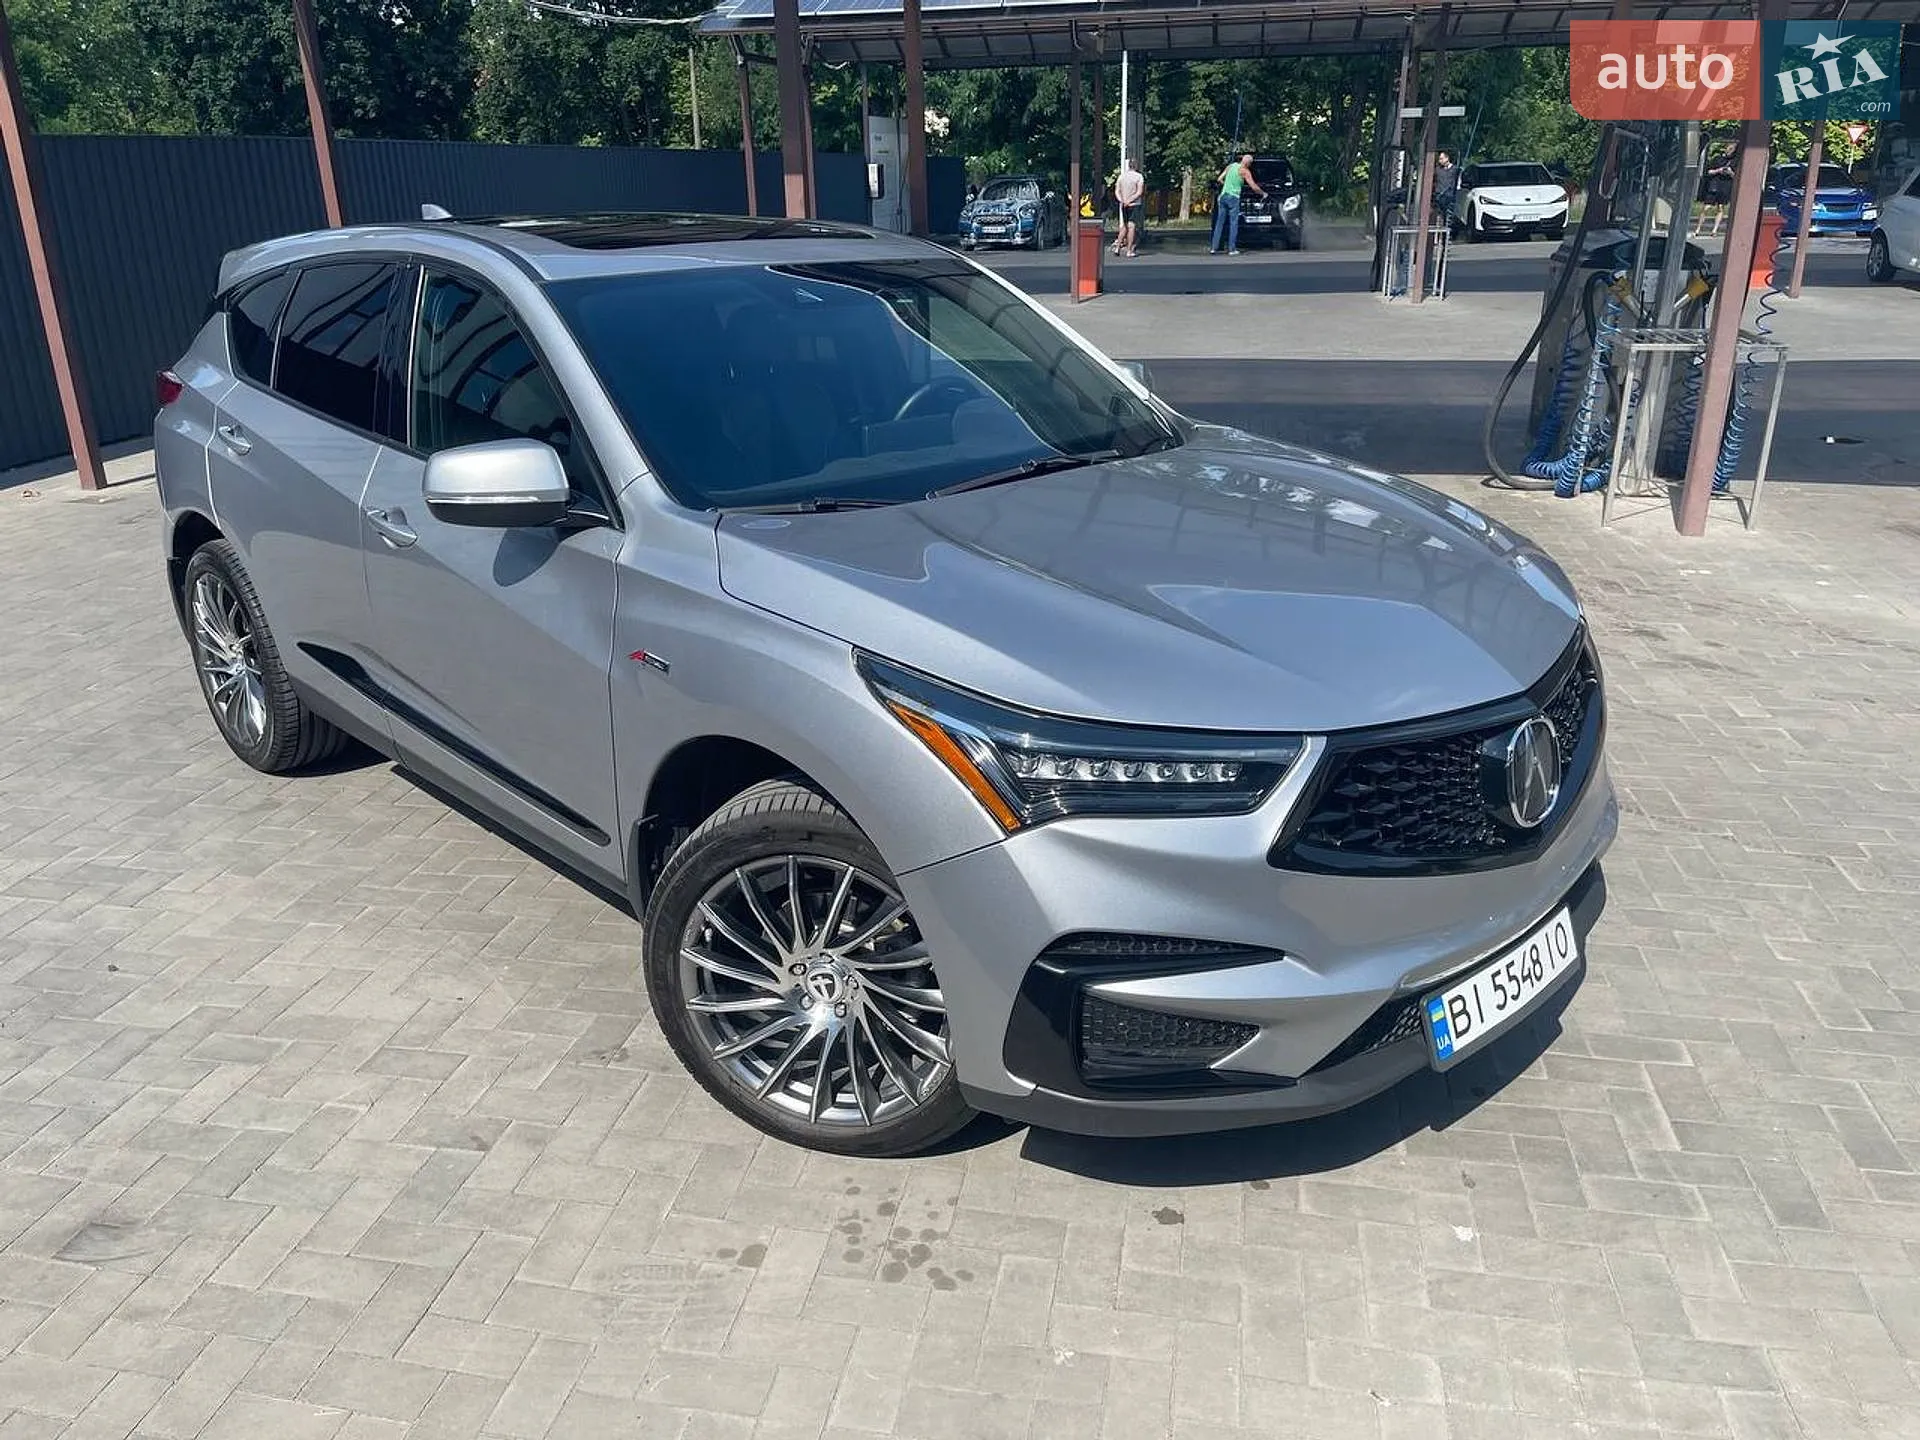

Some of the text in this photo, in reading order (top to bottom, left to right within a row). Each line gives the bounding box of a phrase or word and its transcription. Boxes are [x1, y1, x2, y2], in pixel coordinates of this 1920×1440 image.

[1448, 922, 1568, 1039] BI 5548 IO
[1436, 1033, 1452, 1050] UA
